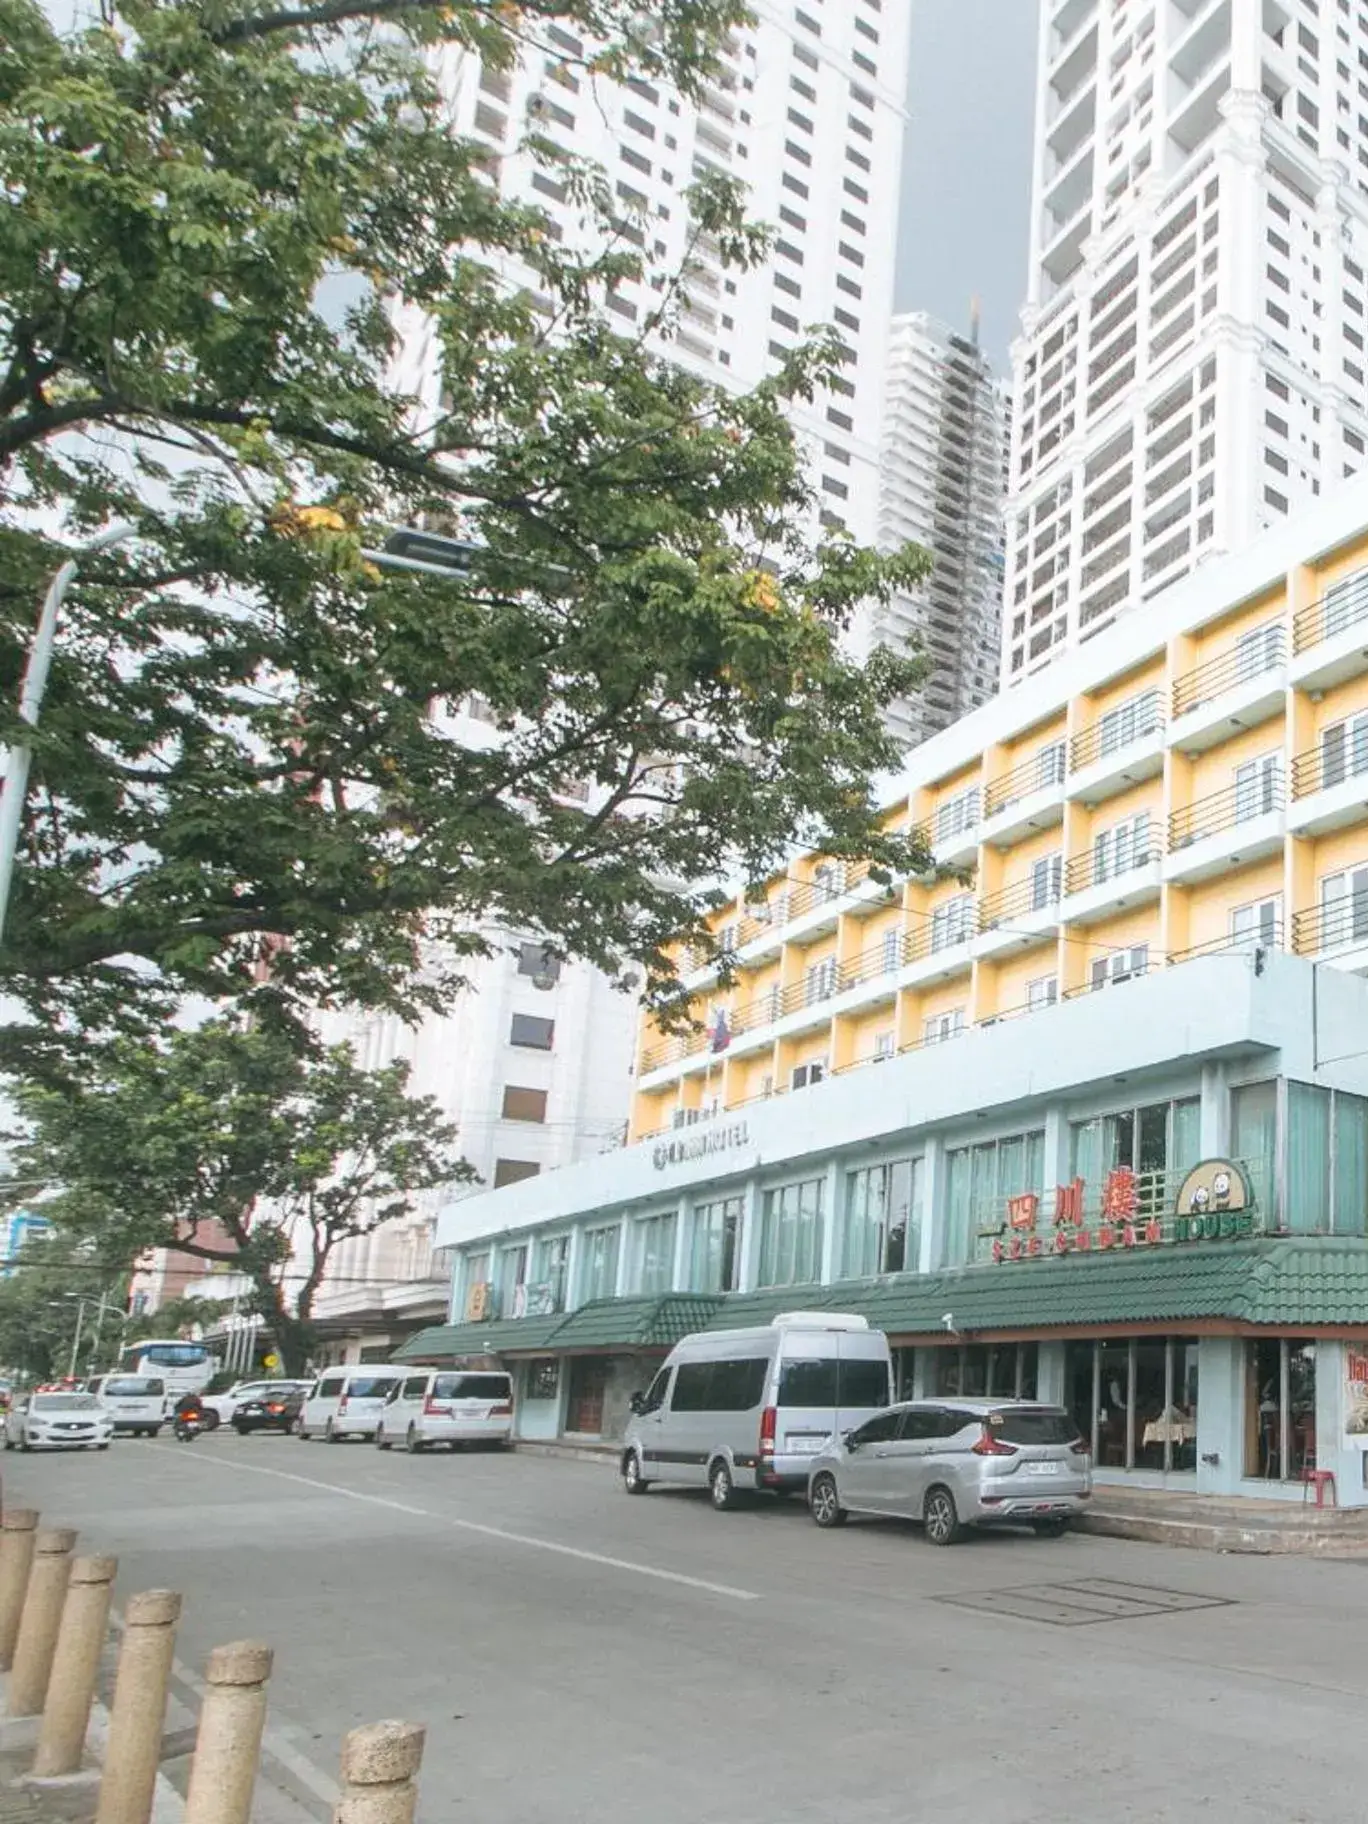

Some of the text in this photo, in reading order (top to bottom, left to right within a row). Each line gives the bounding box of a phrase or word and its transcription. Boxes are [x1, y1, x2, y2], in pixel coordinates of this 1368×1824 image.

[1006, 1165, 1139, 1231] 四川樓
[1175, 1213, 1253, 1241] HOUSE
